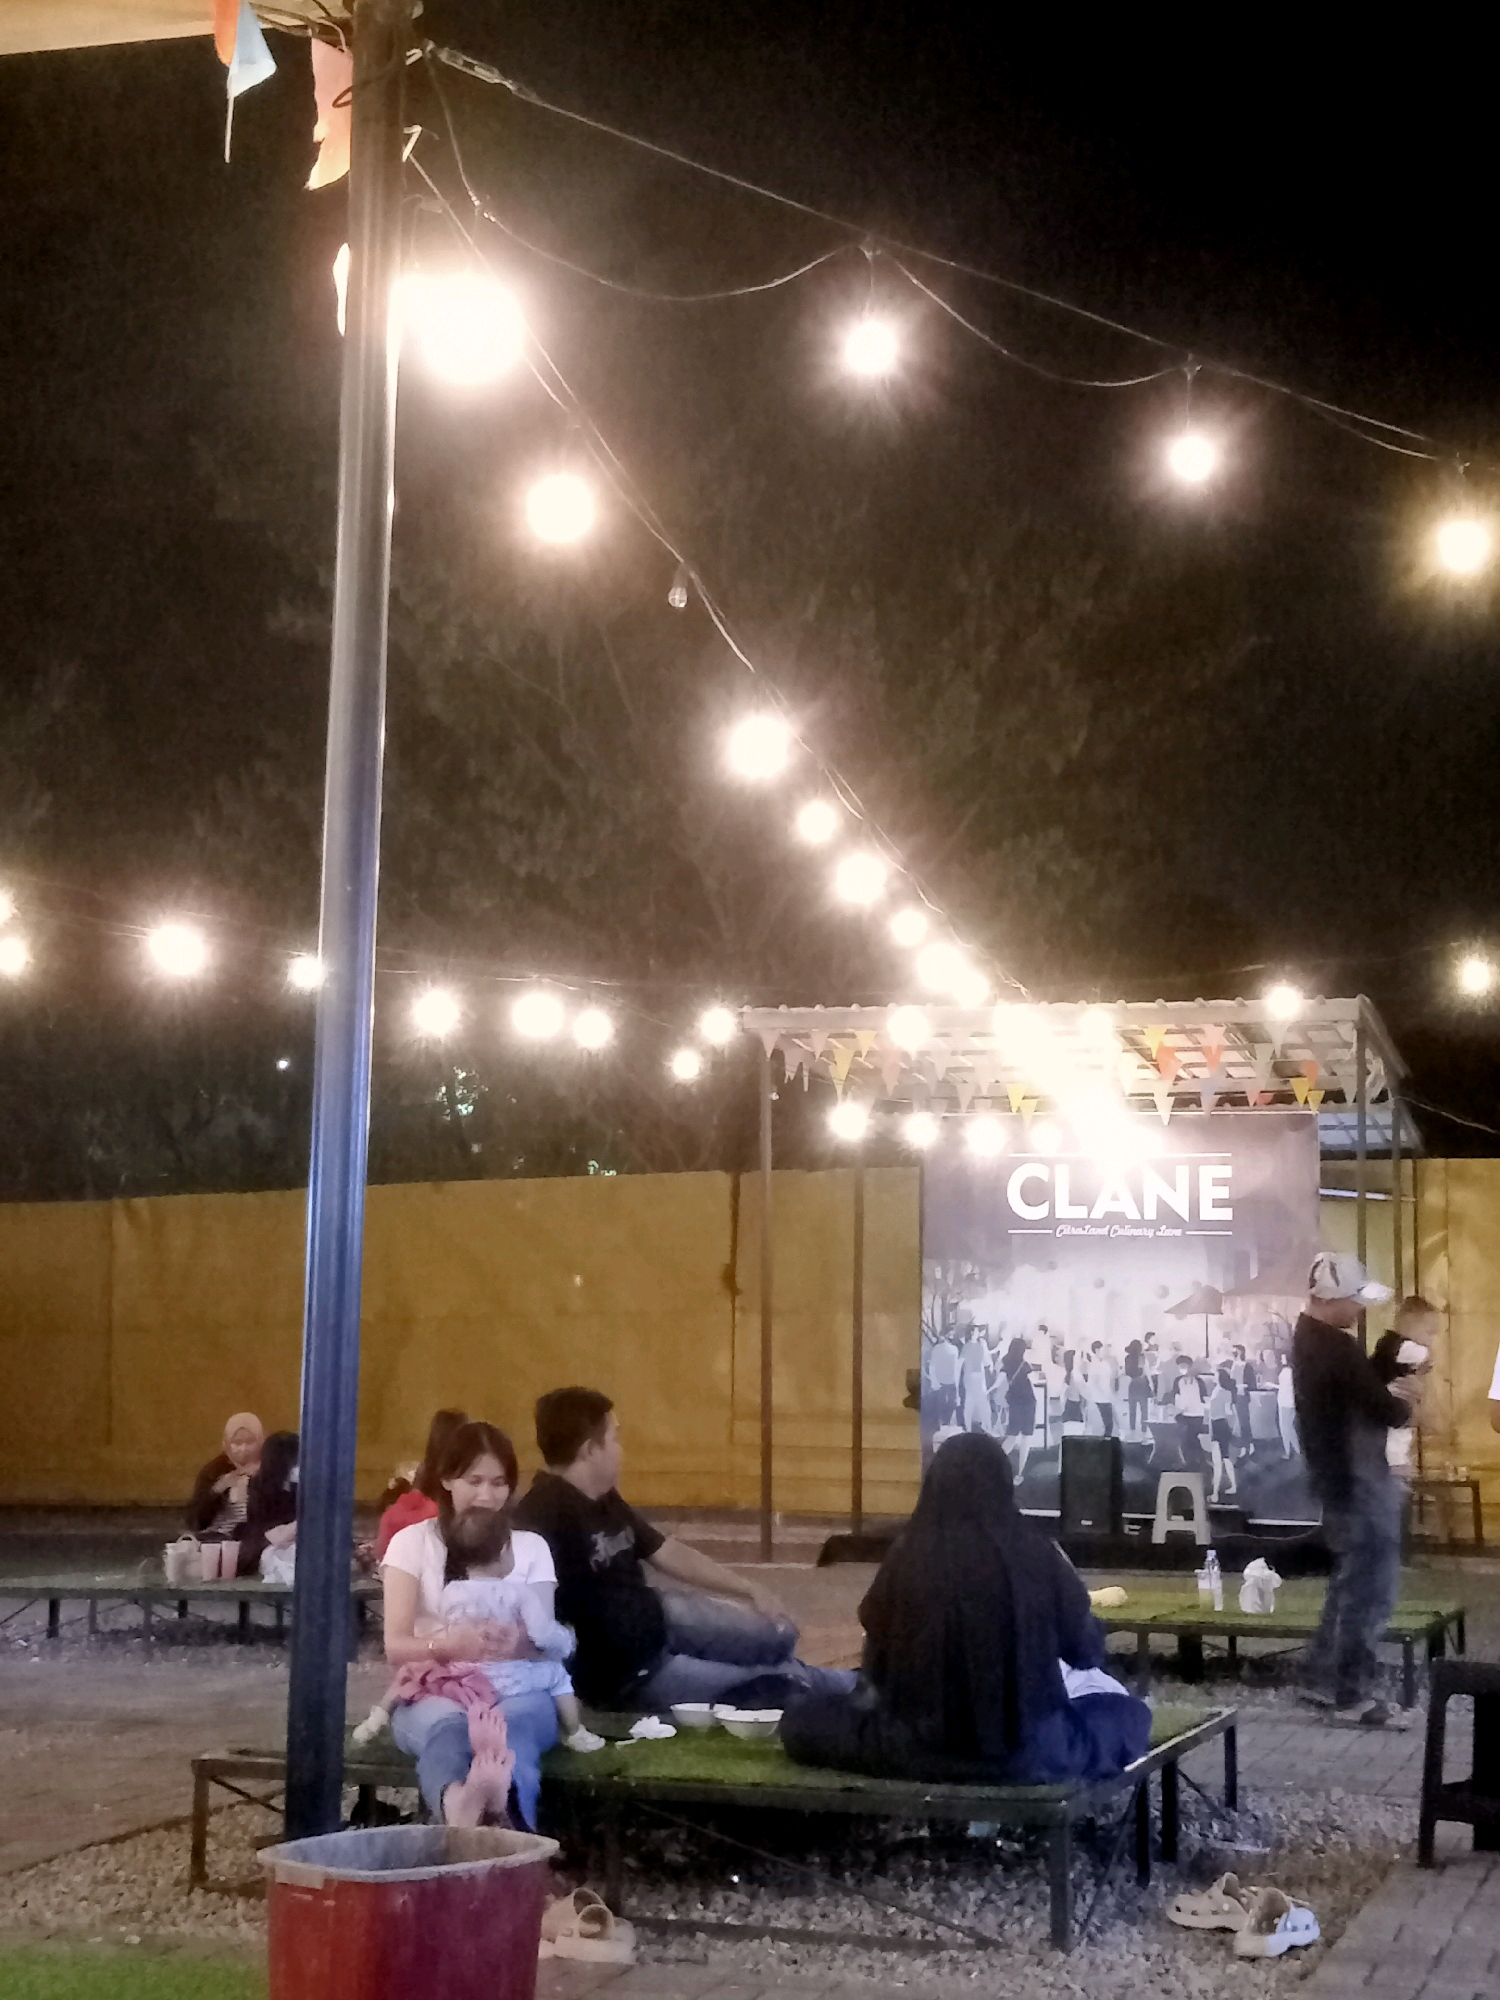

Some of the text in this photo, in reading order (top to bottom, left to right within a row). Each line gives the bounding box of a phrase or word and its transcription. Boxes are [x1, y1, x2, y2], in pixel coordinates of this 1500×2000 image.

[1006, 1162, 1234, 1222] CLANE
[1109, 1224, 1154, 1238] Culinary
[1156, 1225, 1182, 1237] Lane
